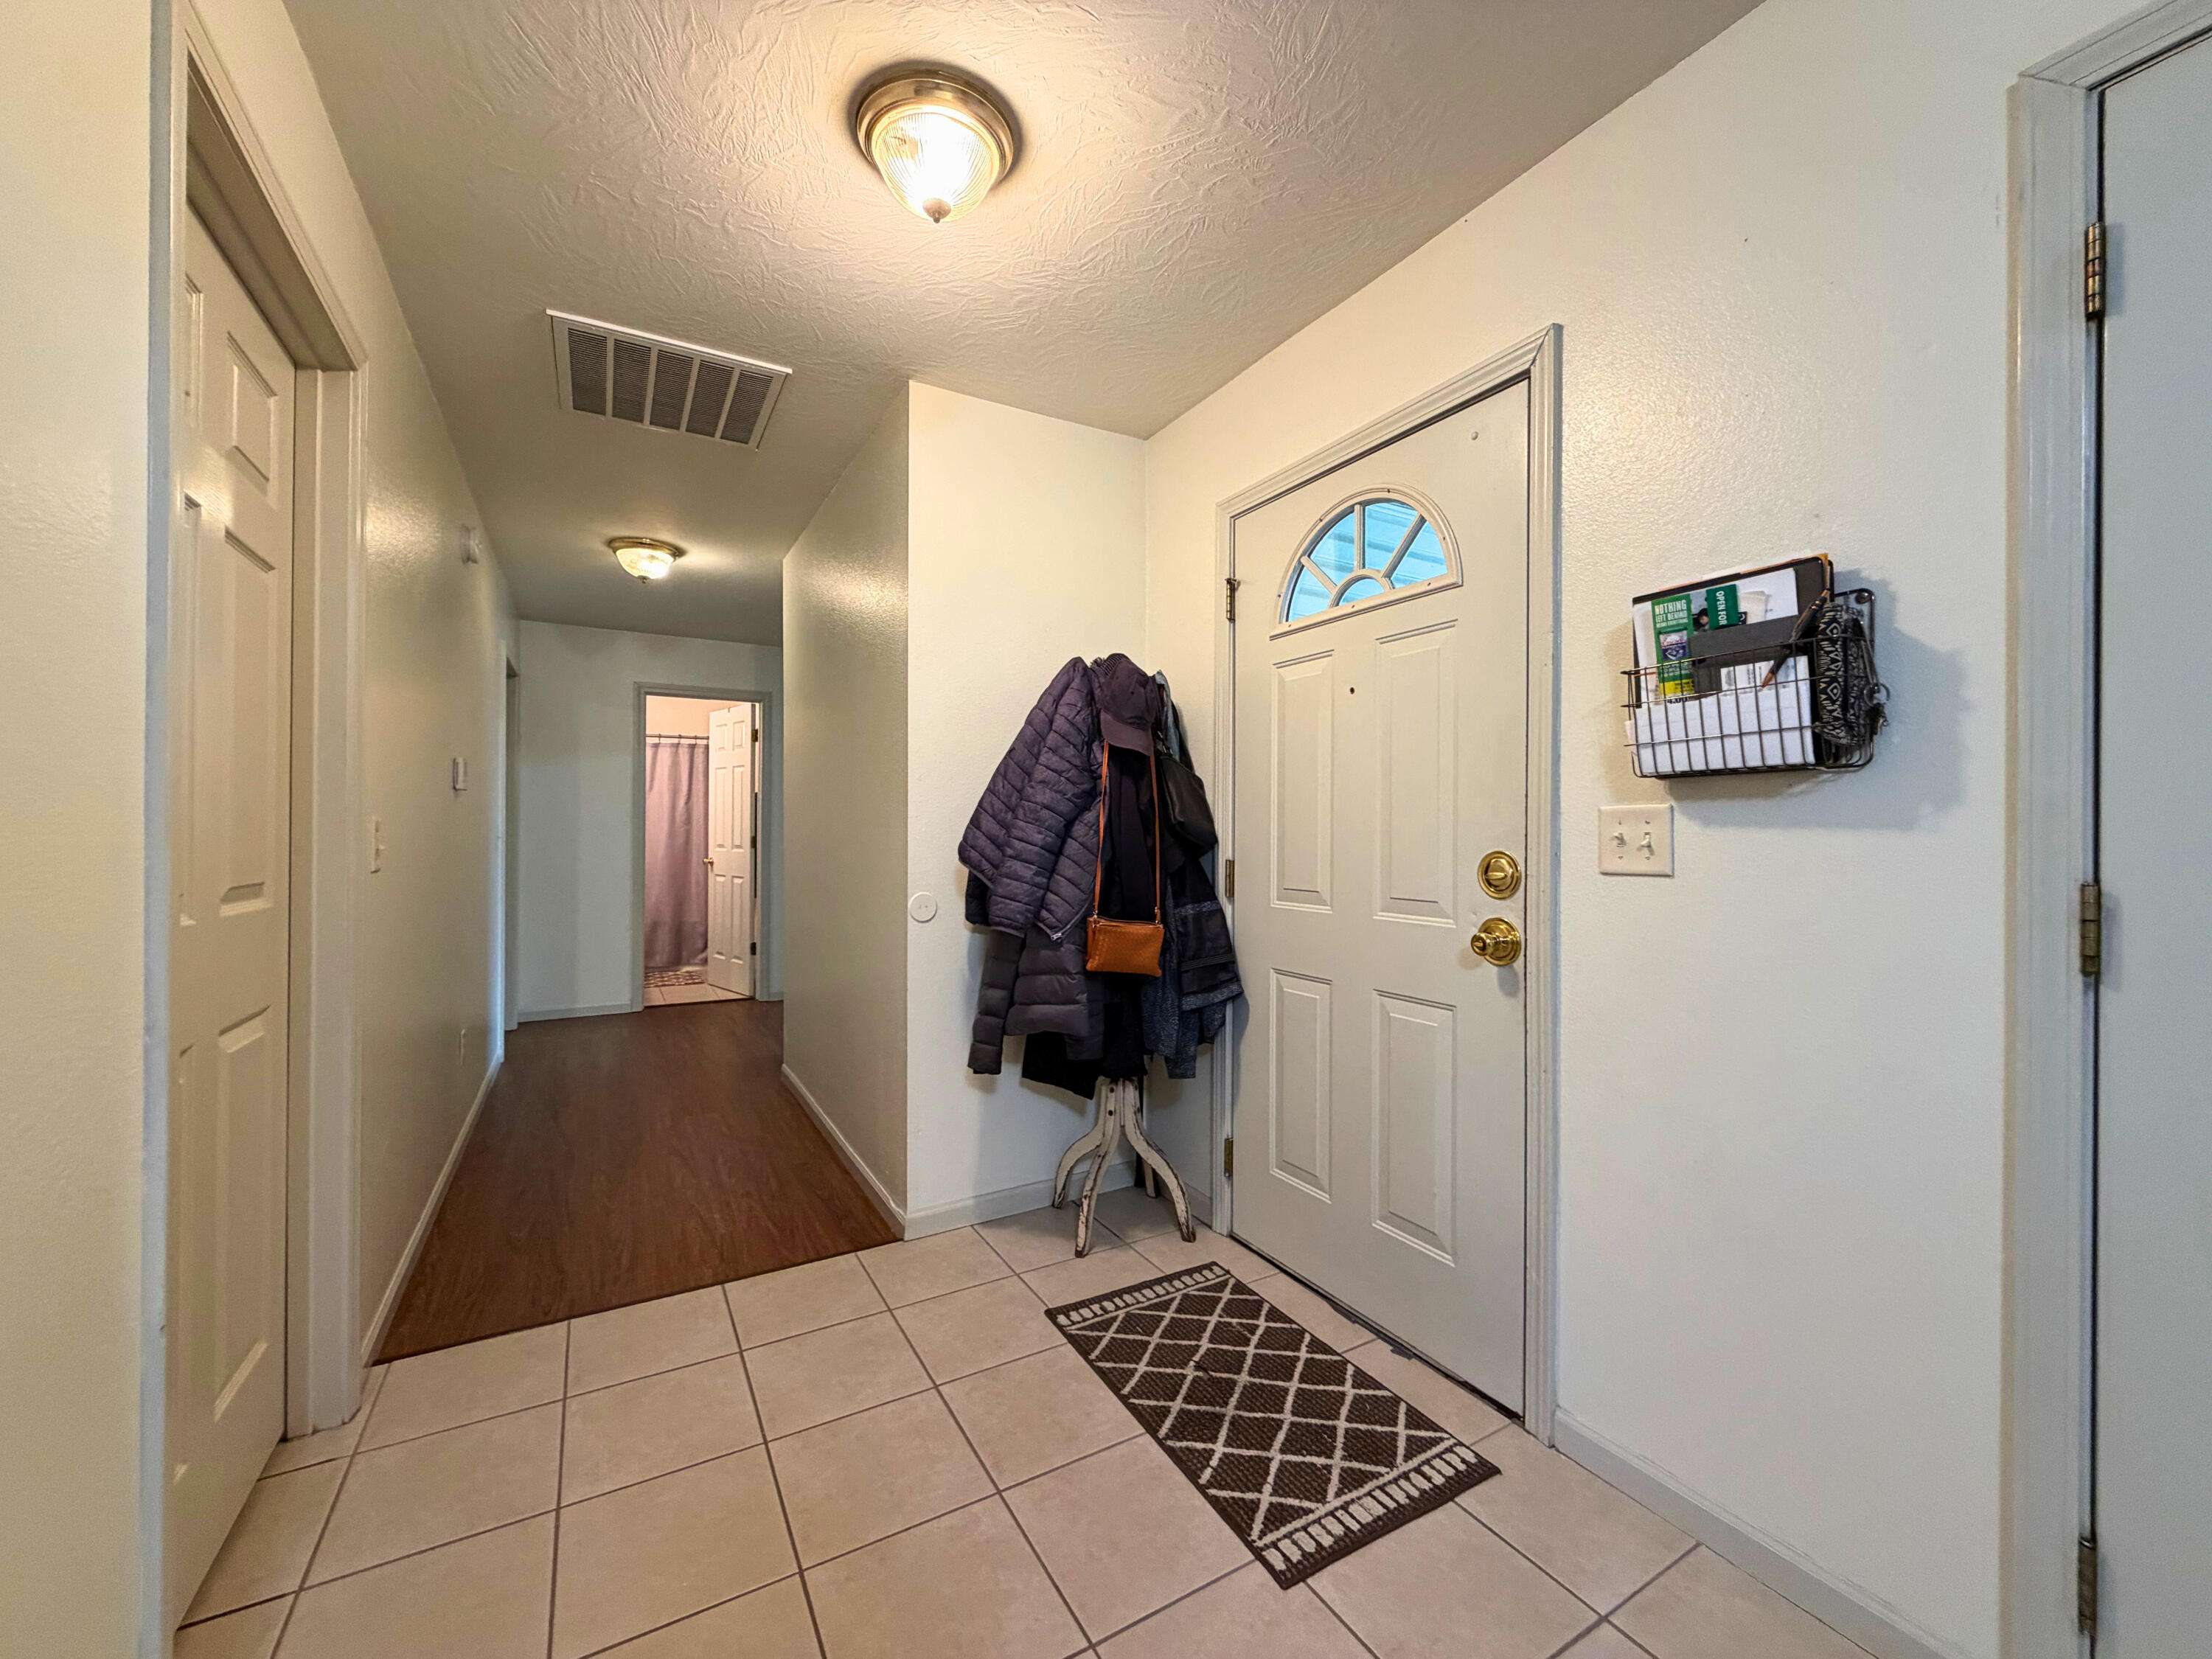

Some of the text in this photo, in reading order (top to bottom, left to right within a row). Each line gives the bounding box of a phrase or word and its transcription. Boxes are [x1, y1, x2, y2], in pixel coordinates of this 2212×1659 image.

[1655, 599, 1687, 615] NOTHING
[1716, 591, 1728, 625] OPEN FOR
